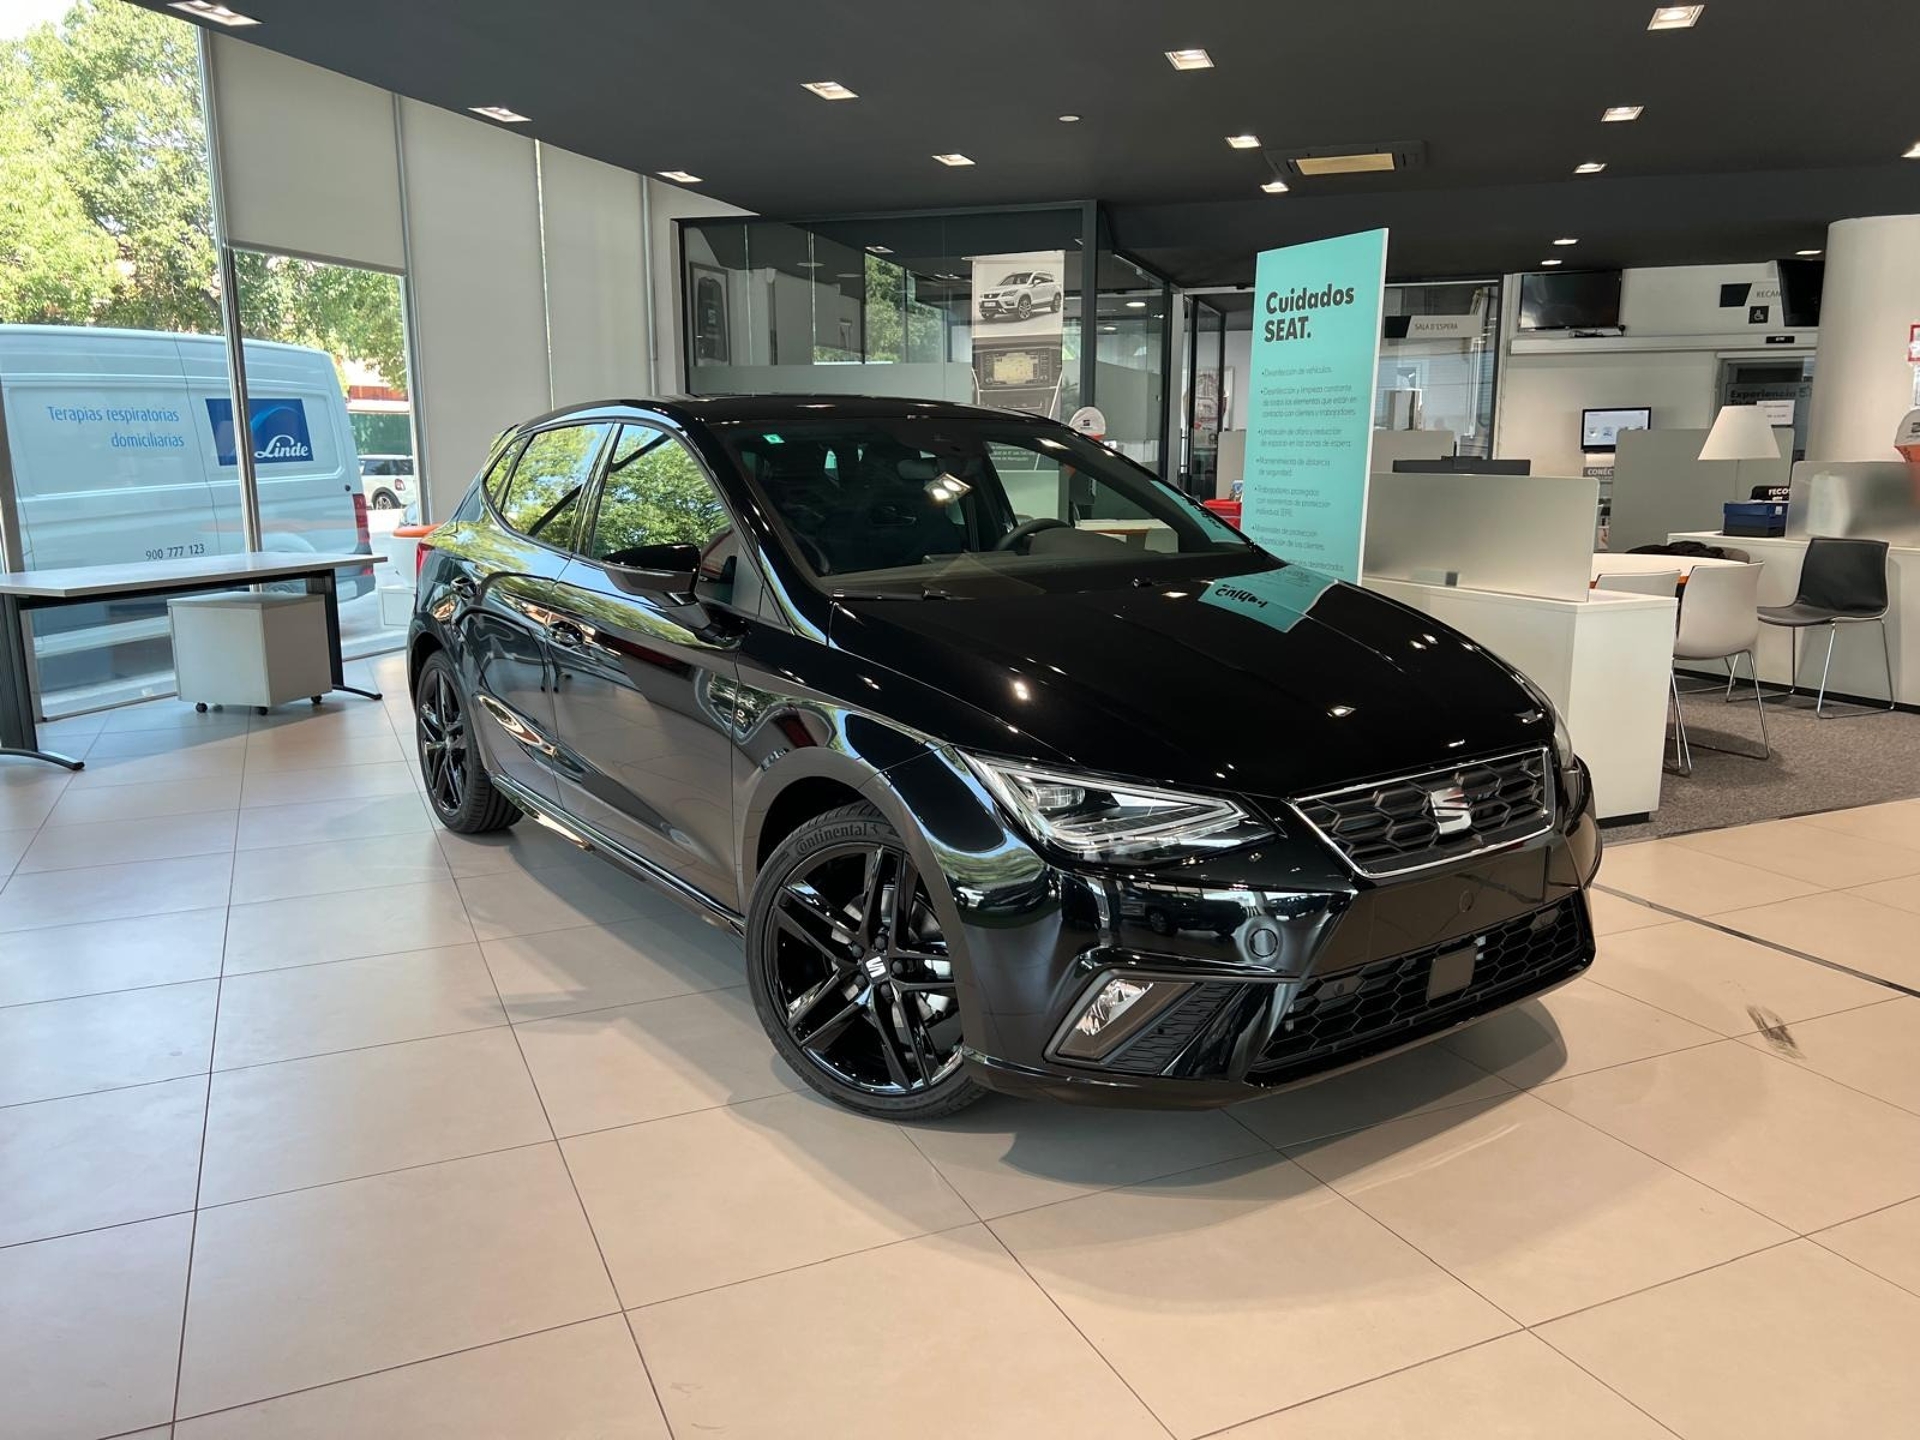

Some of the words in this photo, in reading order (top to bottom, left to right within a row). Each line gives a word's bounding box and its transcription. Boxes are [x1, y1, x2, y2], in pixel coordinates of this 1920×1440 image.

[1265, 283, 1355, 314] Cuidados
[1264, 316, 1311, 343] SEAT.
[1414, 322, 1430, 331] SALA
[47, 406, 103, 424] Terapias
[106, 406, 180, 424] respiratorias
[110, 431, 185, 448] domiciliarias
[254, 434, 309, 458] Linde
[1587, 467, 1613, 477] CONÉC
[145, 548, 164, 560] 900
[167, 545, 184, 557] 777
[189, 543, 205, 554] 123
[796, 822, 868, 854] Continental
